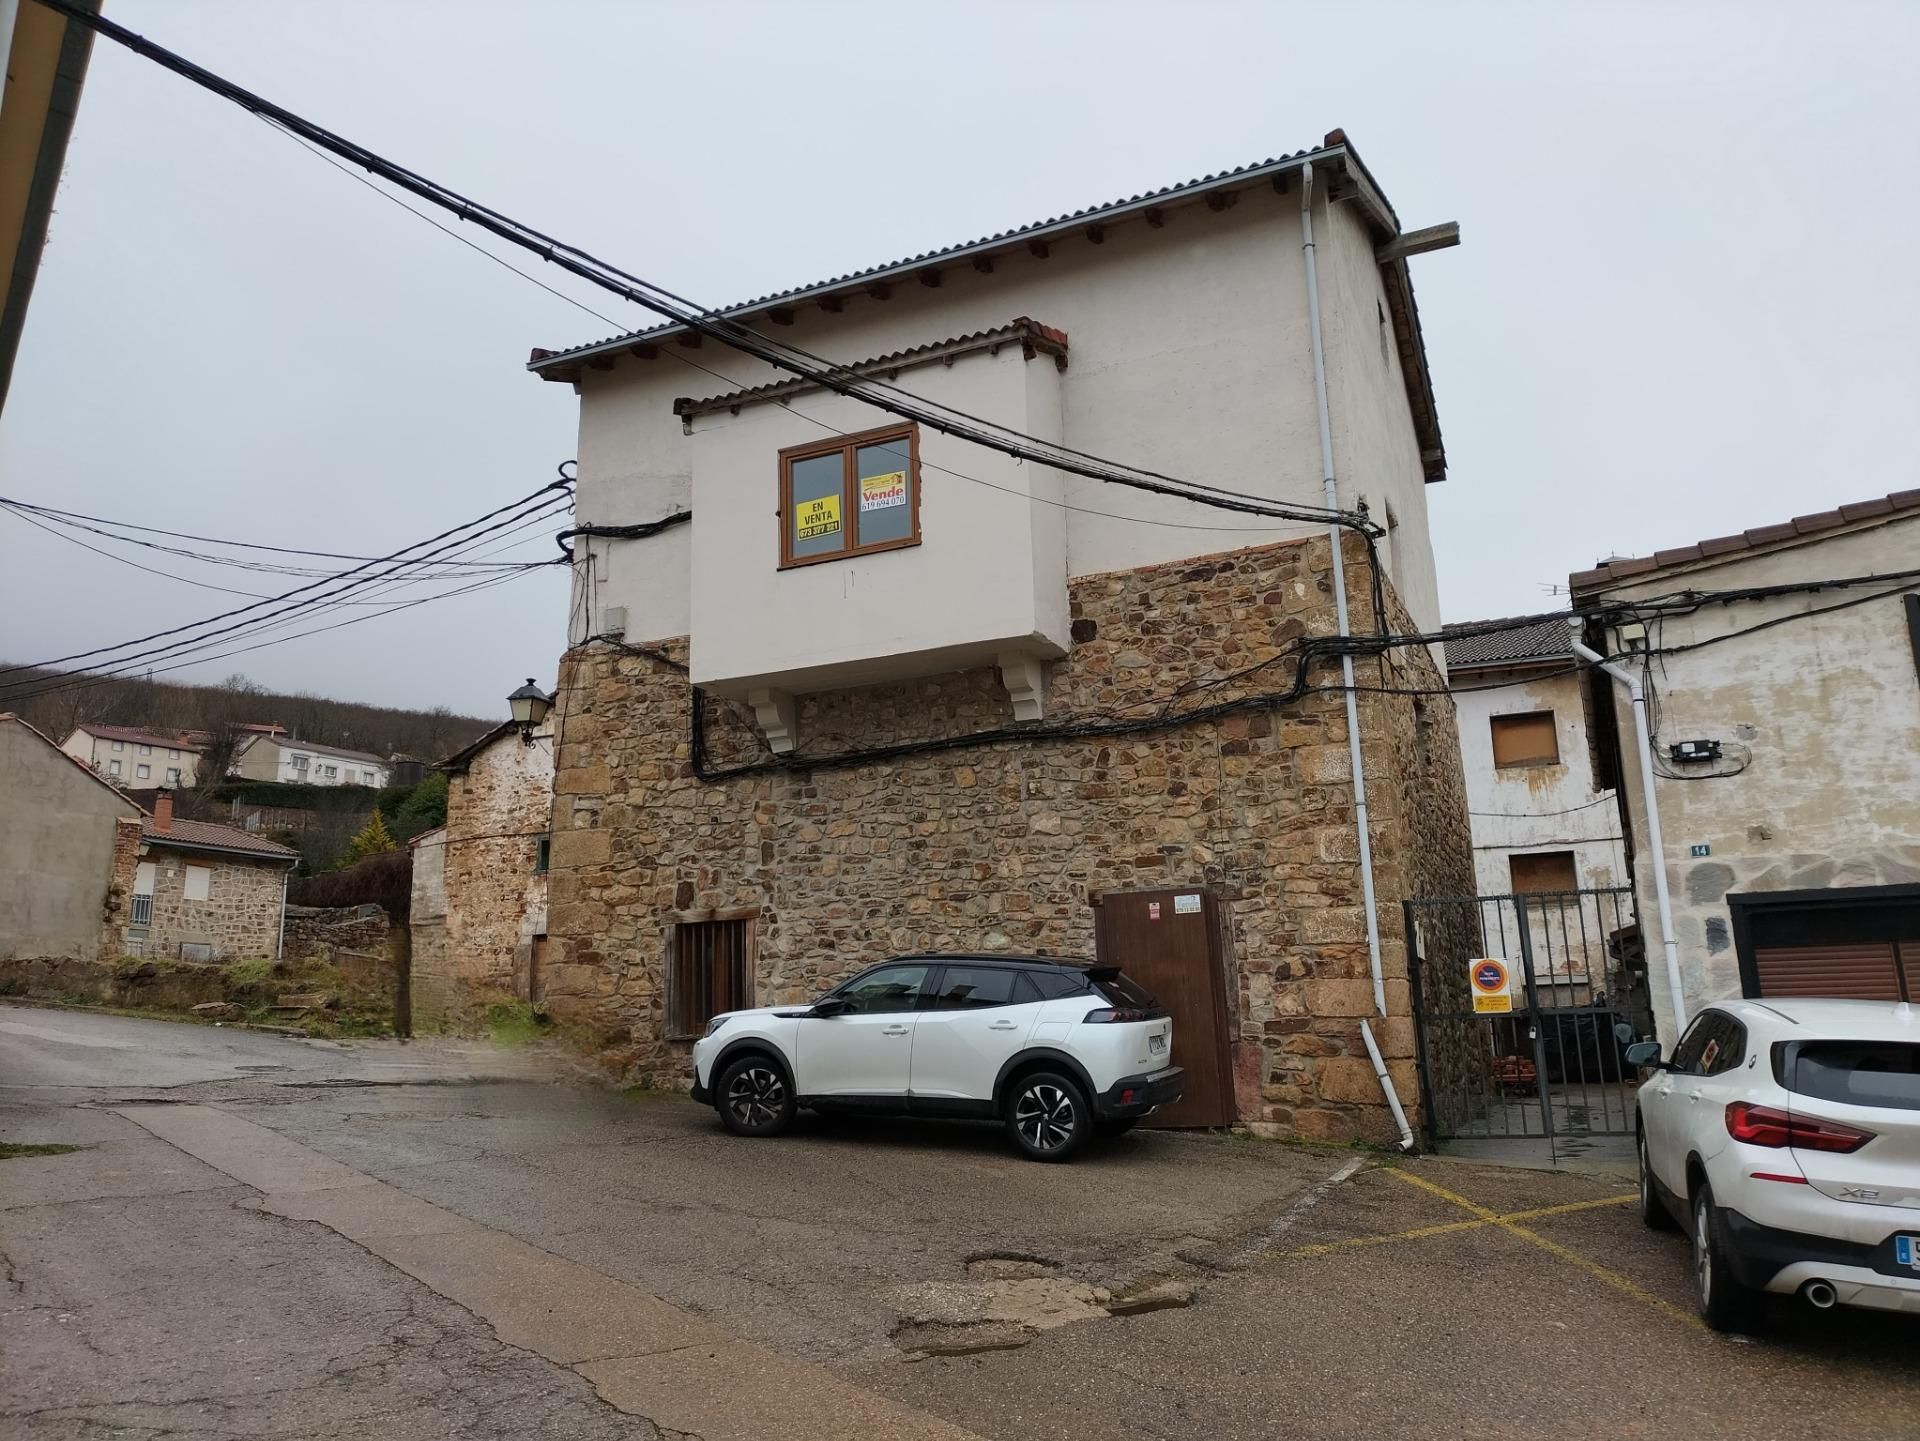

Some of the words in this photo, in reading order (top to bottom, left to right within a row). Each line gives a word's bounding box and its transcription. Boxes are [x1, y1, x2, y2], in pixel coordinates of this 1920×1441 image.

[863, 486, 904, 502] Vende
[812, 501, 823, 512] EN
[862, 502, 875, 510] 619
[876, 499, 890, 508] 694
[891, 496, 905, 505] 070
[804, 510, 833, 525] VENTA
[1839, 1187, 1880, 1199] X2
